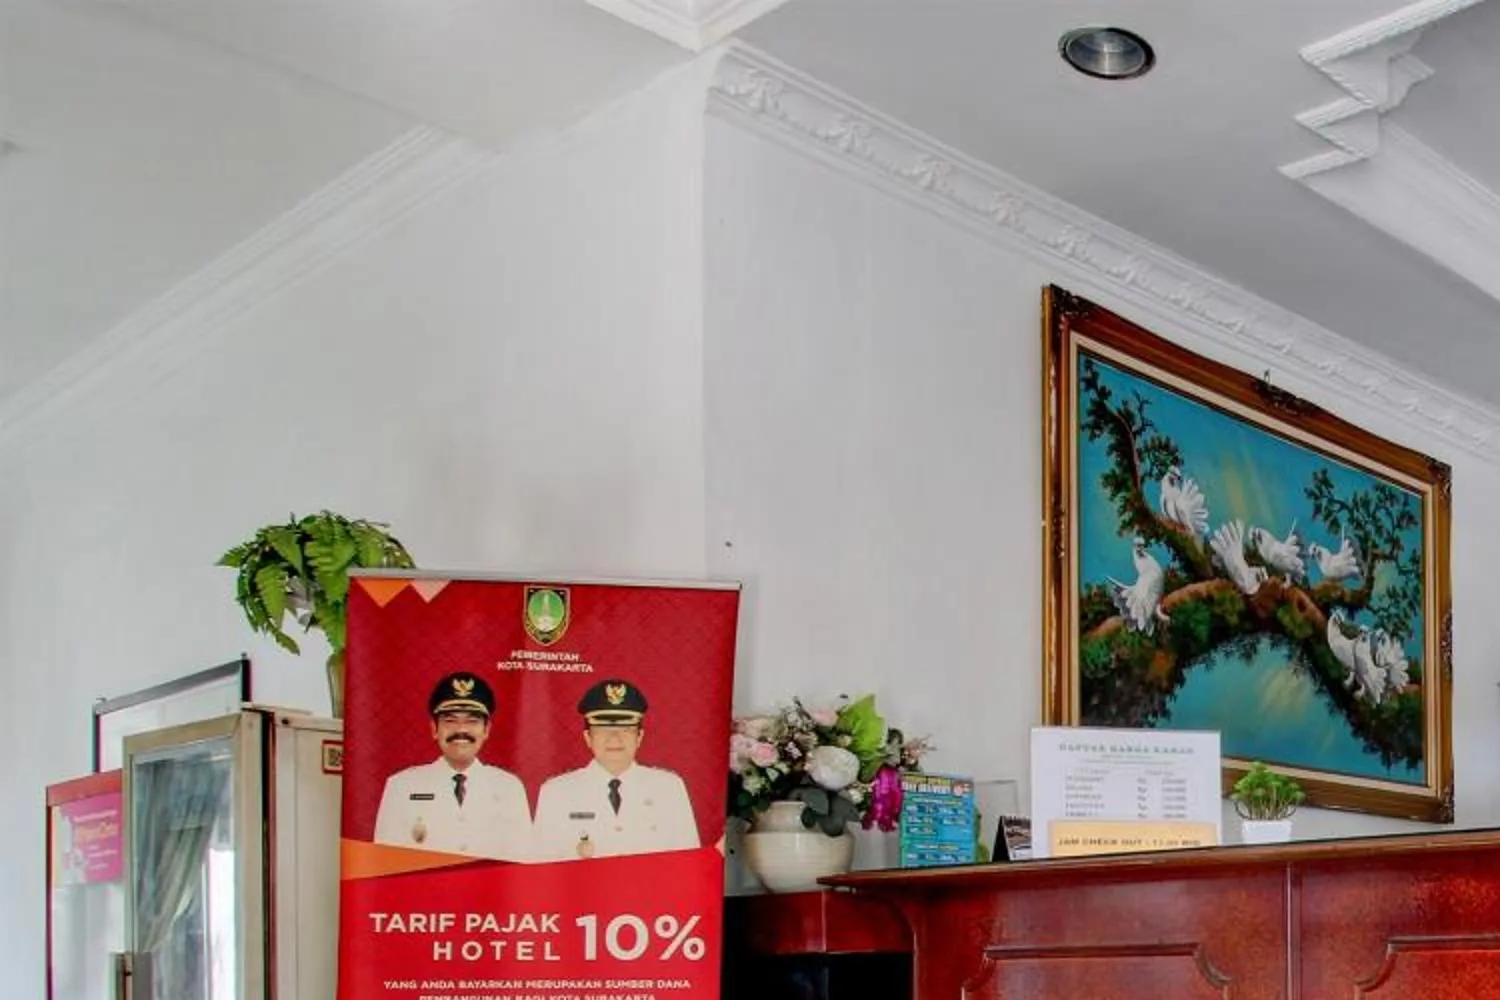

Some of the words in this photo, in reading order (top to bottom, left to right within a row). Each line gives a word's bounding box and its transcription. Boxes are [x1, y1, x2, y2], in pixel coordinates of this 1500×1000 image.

[511, 650, 579, 662] PEMERINTAH
[497, 661, 524, 671] KOTA
[527, 662, 594, 673] SURAKARTA
[1058, 838, 1080, 847] JAM
[1082, 838, 1118, 847] CHECK
[369, 912, 456, 933] TARIF
[465, 912, 561, 933] PAJAK
[575, 913, 705, 961] 10%
[433, 941, 561, 961] HOTEL
[383, 979, 417, 989] YANG
[421, 979, 455, 989] ANDA
[458, 979, 522, 989] BAYARKAN
[526, 979, 602, 989] MERUPAKAN
[605, 979, 654, 989] SUMBER
[657, 979, 691, 989] DANA
